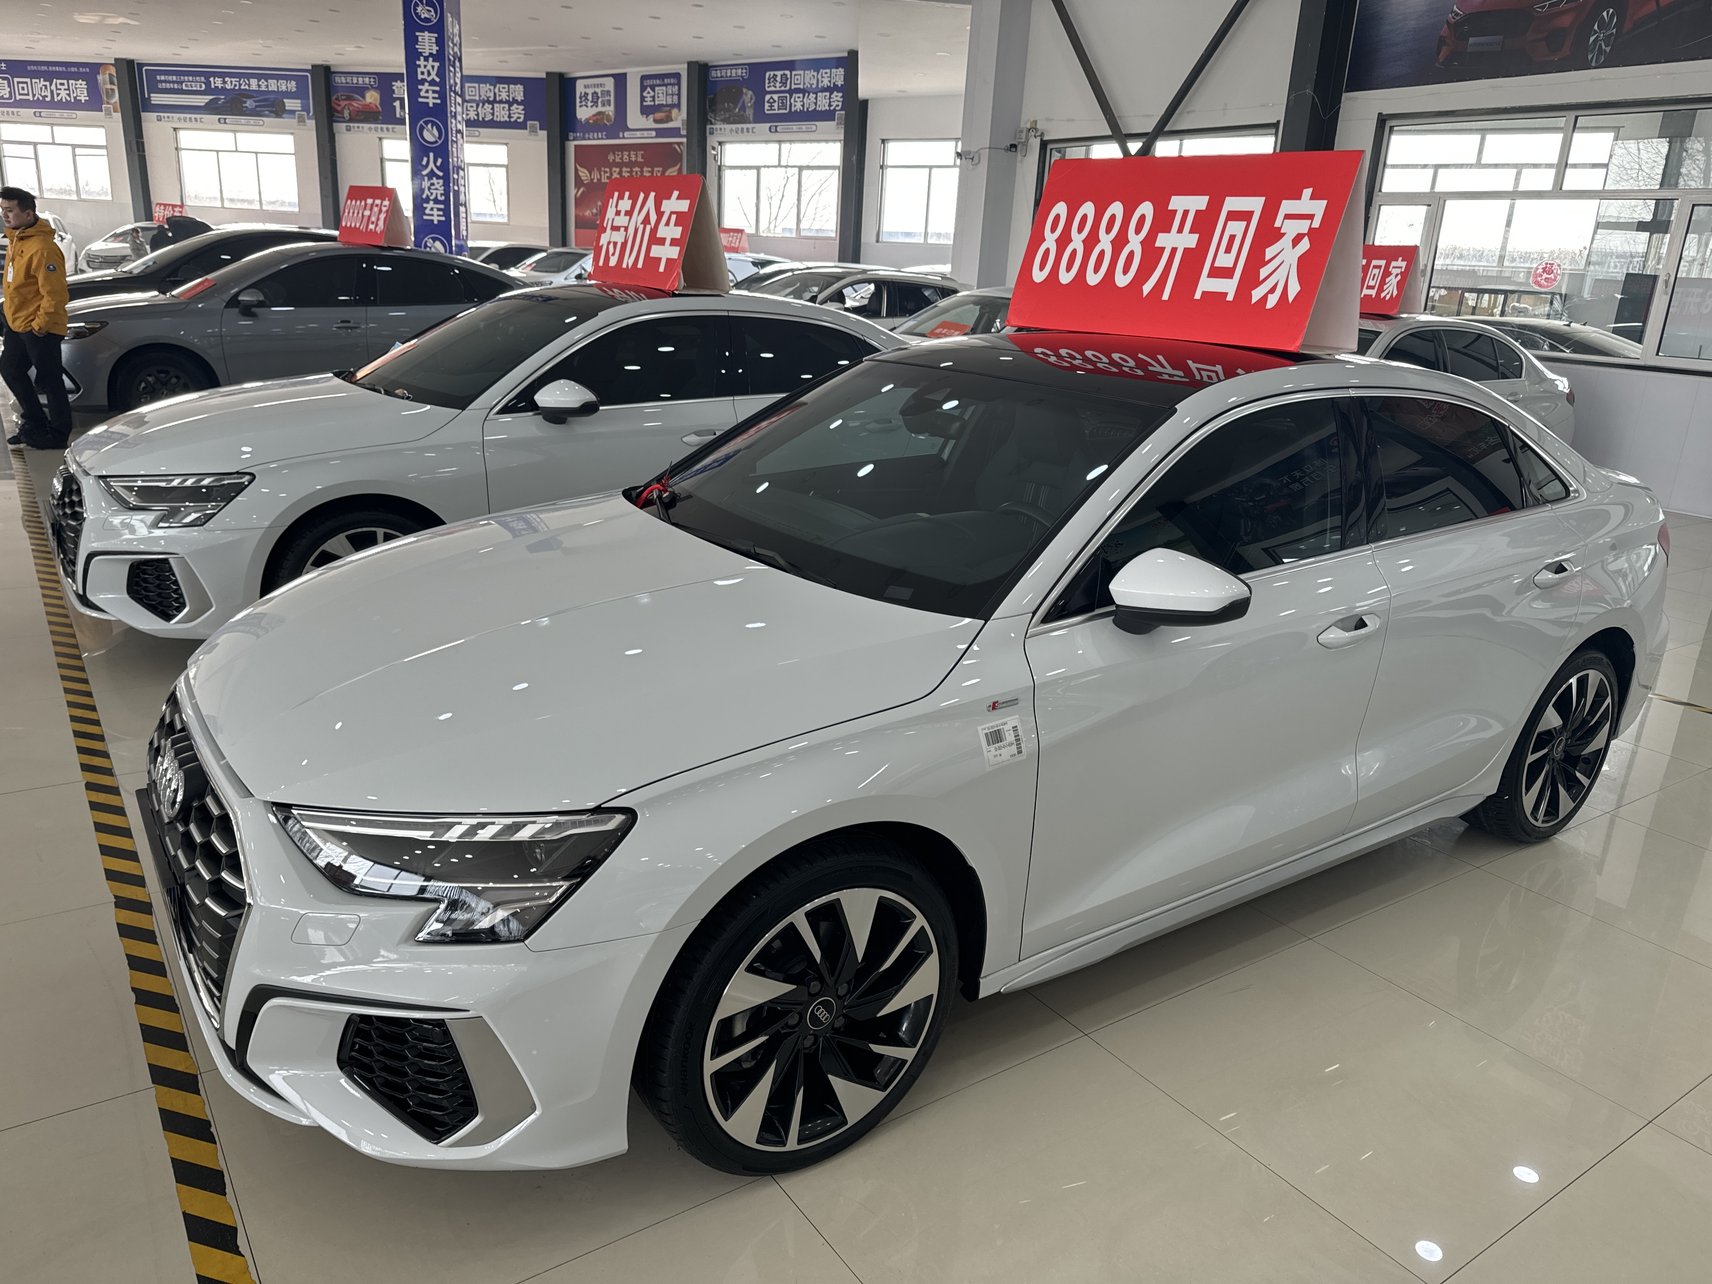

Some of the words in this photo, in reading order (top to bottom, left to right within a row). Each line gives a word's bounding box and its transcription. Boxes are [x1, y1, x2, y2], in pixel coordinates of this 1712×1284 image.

[415, 30, 441, 108] 事故车
[766, 67, 845, 90] 终身回购保障
[209, 76, 297, 92] 1年3万公里全国保修
[464, 83, 525, 102] 回购保障
[578, 91, 600, 108] 终身
[643, 86, 667, 105] 全国
[765, 91, 844, 113] 全国保修服务
[463, 102, 526, 122] 保修服务
[421, 152, 446, 225] 火烧车
[341, 197, 390, 234] 8888开回家
[598, 190, 691, 273] 特价车
[1031, 187, 1328, 310] 8888开回家
